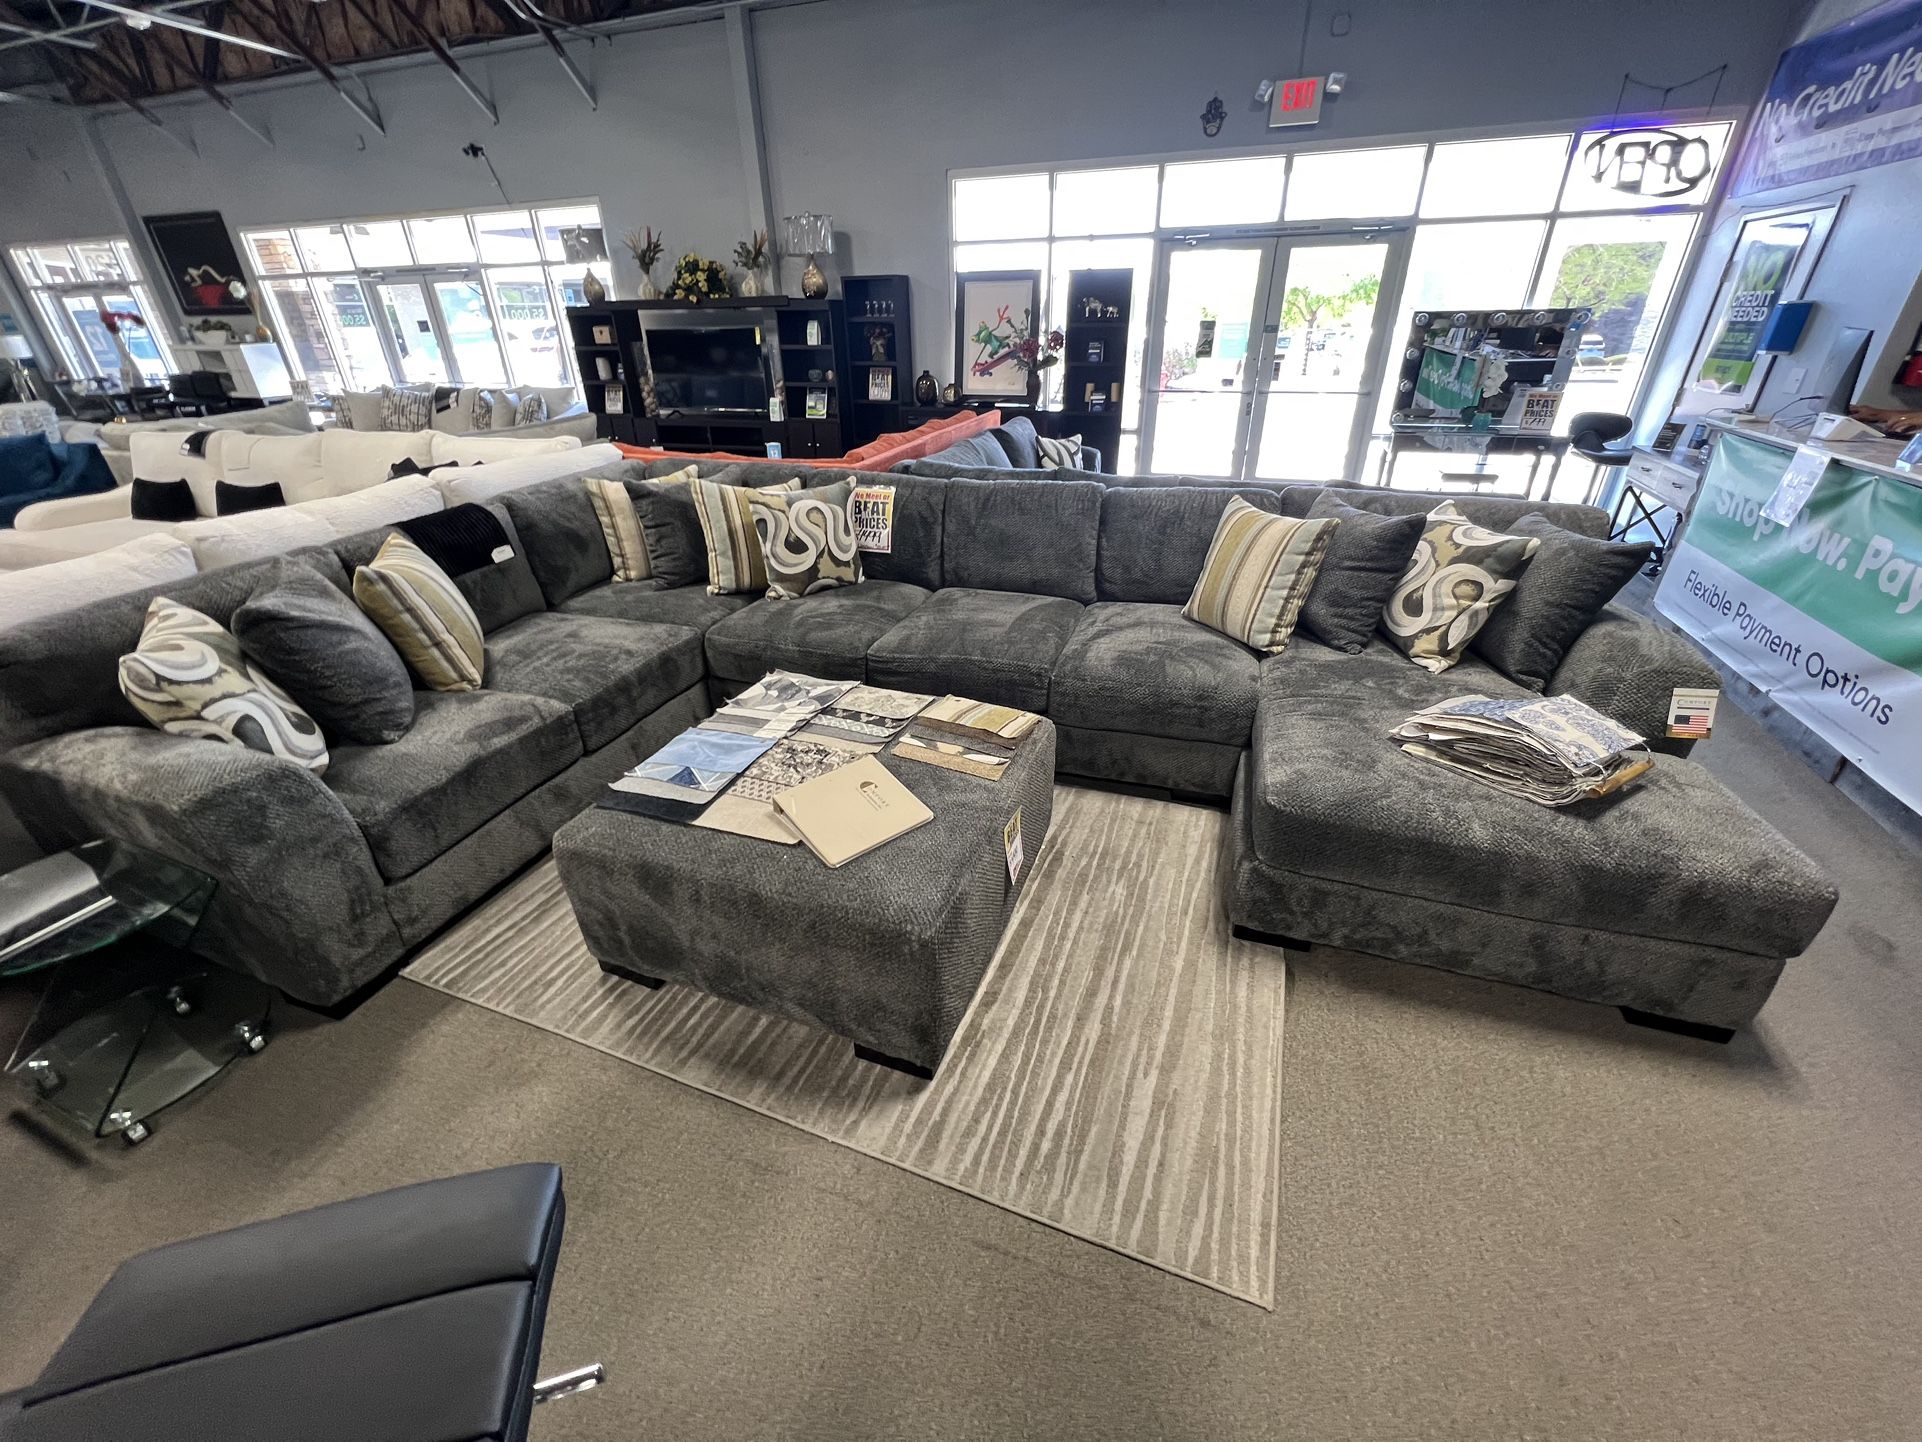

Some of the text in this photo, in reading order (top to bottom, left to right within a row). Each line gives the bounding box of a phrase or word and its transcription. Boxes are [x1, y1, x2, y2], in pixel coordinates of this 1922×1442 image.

[1281, 79, 1318, 112] EXIT
[1757, 99, 1788, 138] No
[1792, 63, 1877, 122] Credit
[1732, 290, 1775, 307] CREDIT
[1524, 409, 1554, 418] PRICES
[1526, 398, 1557, 409] BEAT
[854, 500, 889, 517] BEAT
[1716, 485, 1776, 541] Shop
[1683, 569, 1732, 617] Flexible
[1732, 601, 1802, 668] Payment
[1805, 651, 1895, 727] Options
